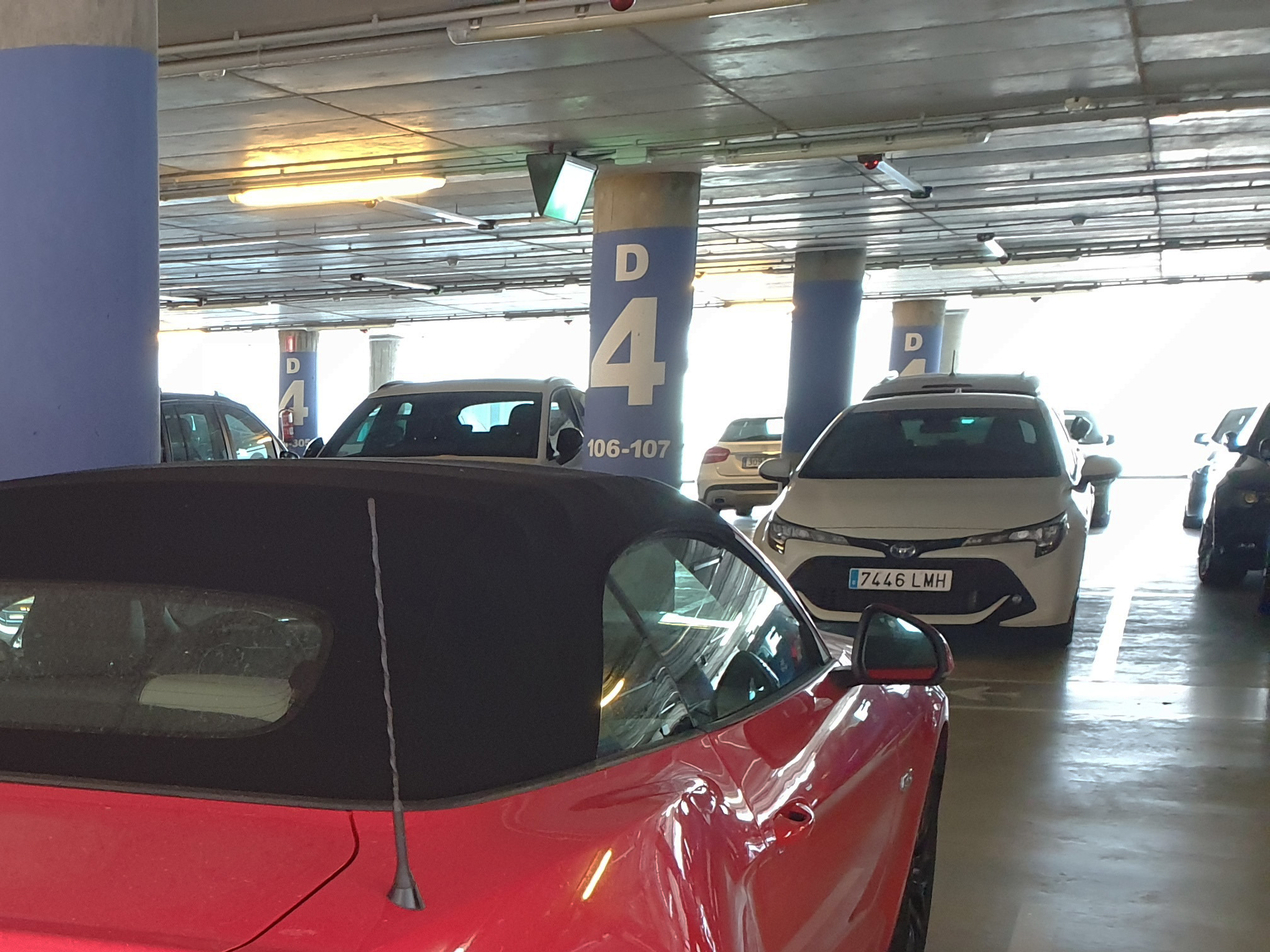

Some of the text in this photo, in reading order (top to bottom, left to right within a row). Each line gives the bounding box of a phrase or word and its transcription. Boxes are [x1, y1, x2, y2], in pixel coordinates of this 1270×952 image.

[615, 243, 649, 281] D
[590, 297, 666, 406] 4
[904, 332, 923, 352] D
[286, 357, 301, 374] D
[278, 379, 309, 426] 4
[587, 438, 671, 459] 106-107
[860, 571, 947, 589] 7446 LMH
